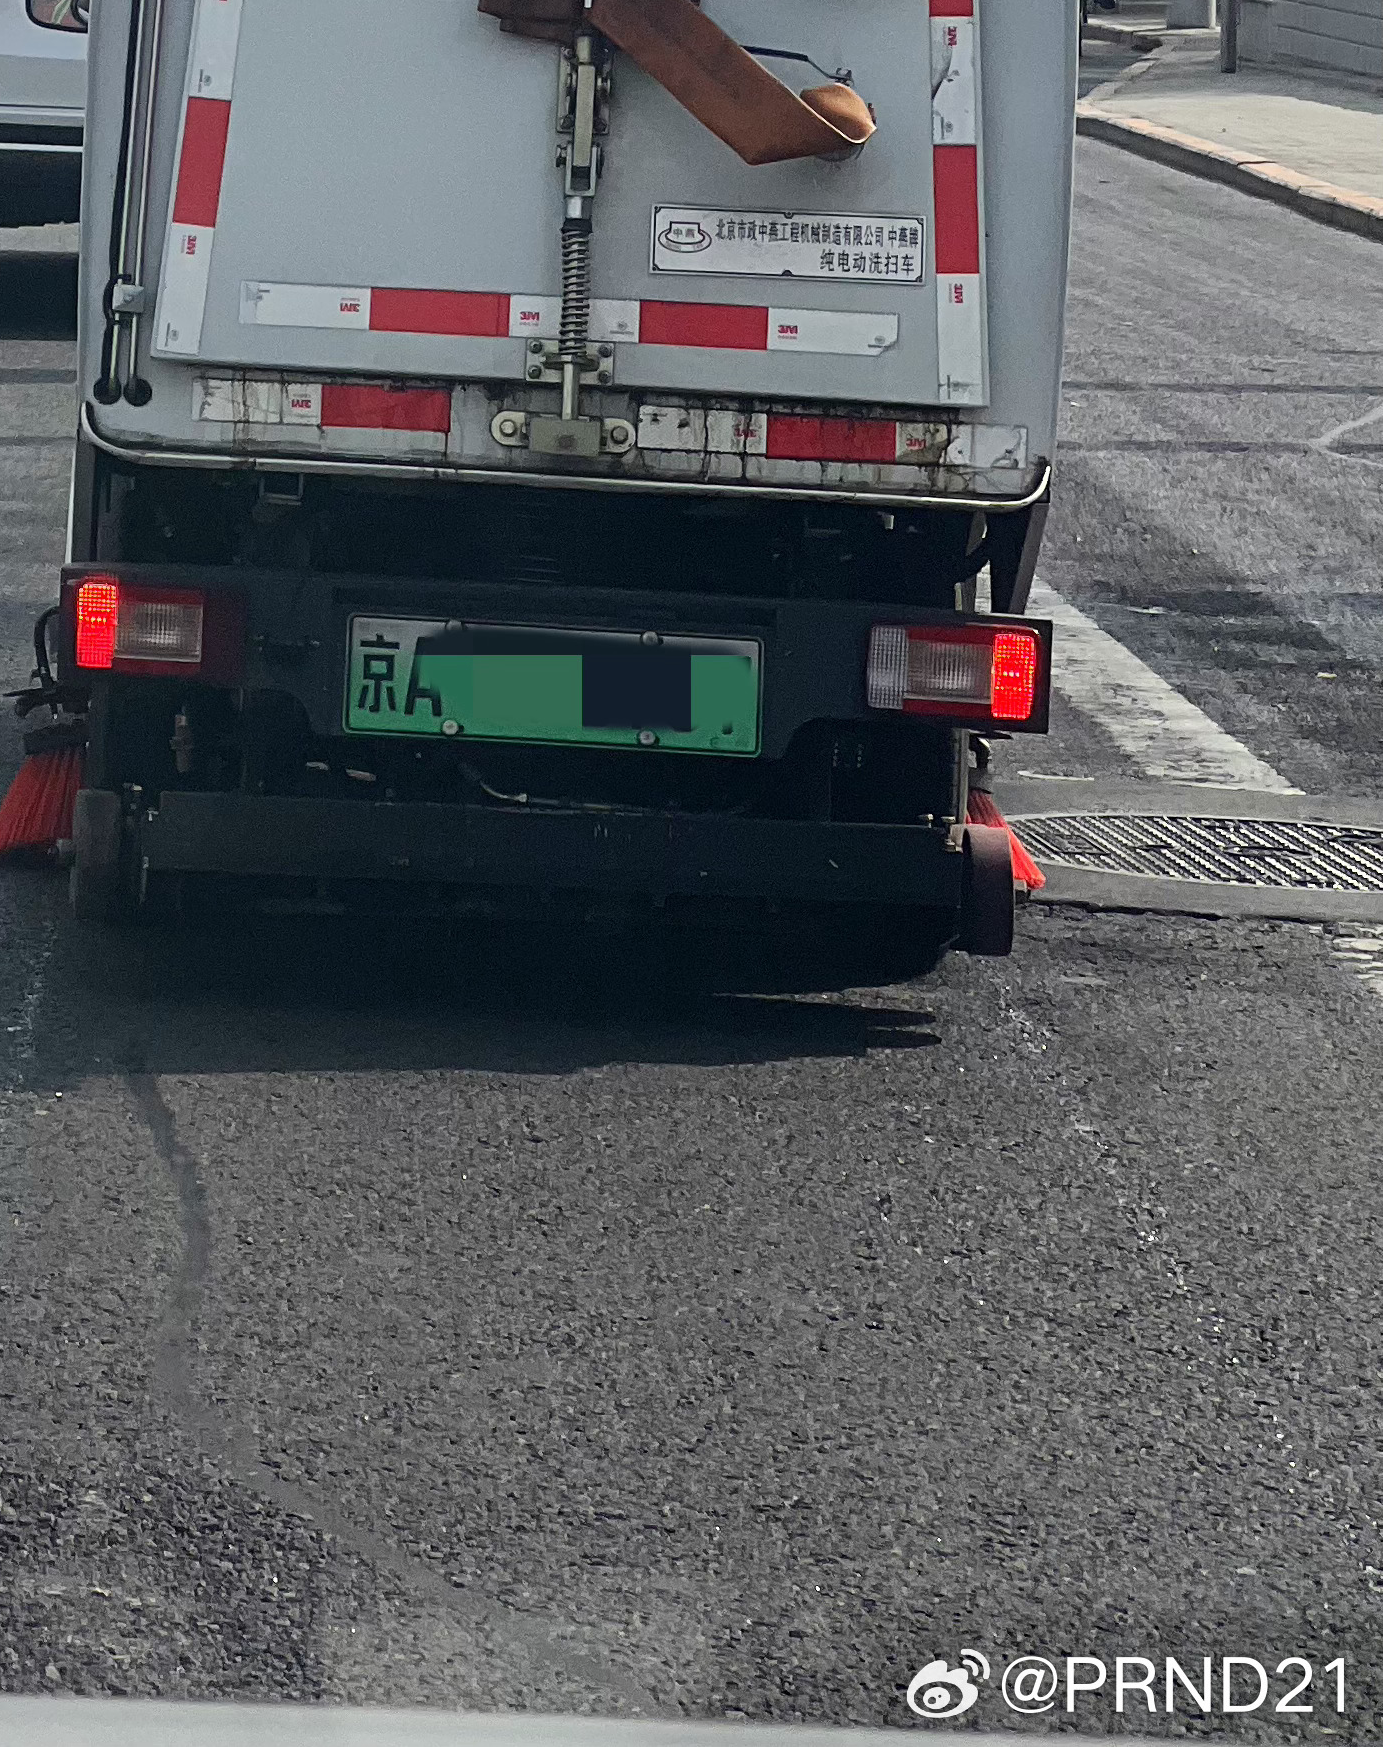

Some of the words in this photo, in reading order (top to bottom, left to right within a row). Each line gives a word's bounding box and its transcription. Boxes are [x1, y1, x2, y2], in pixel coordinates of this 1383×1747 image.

[820, 249, 915, 275] 纯电动洗扫车
